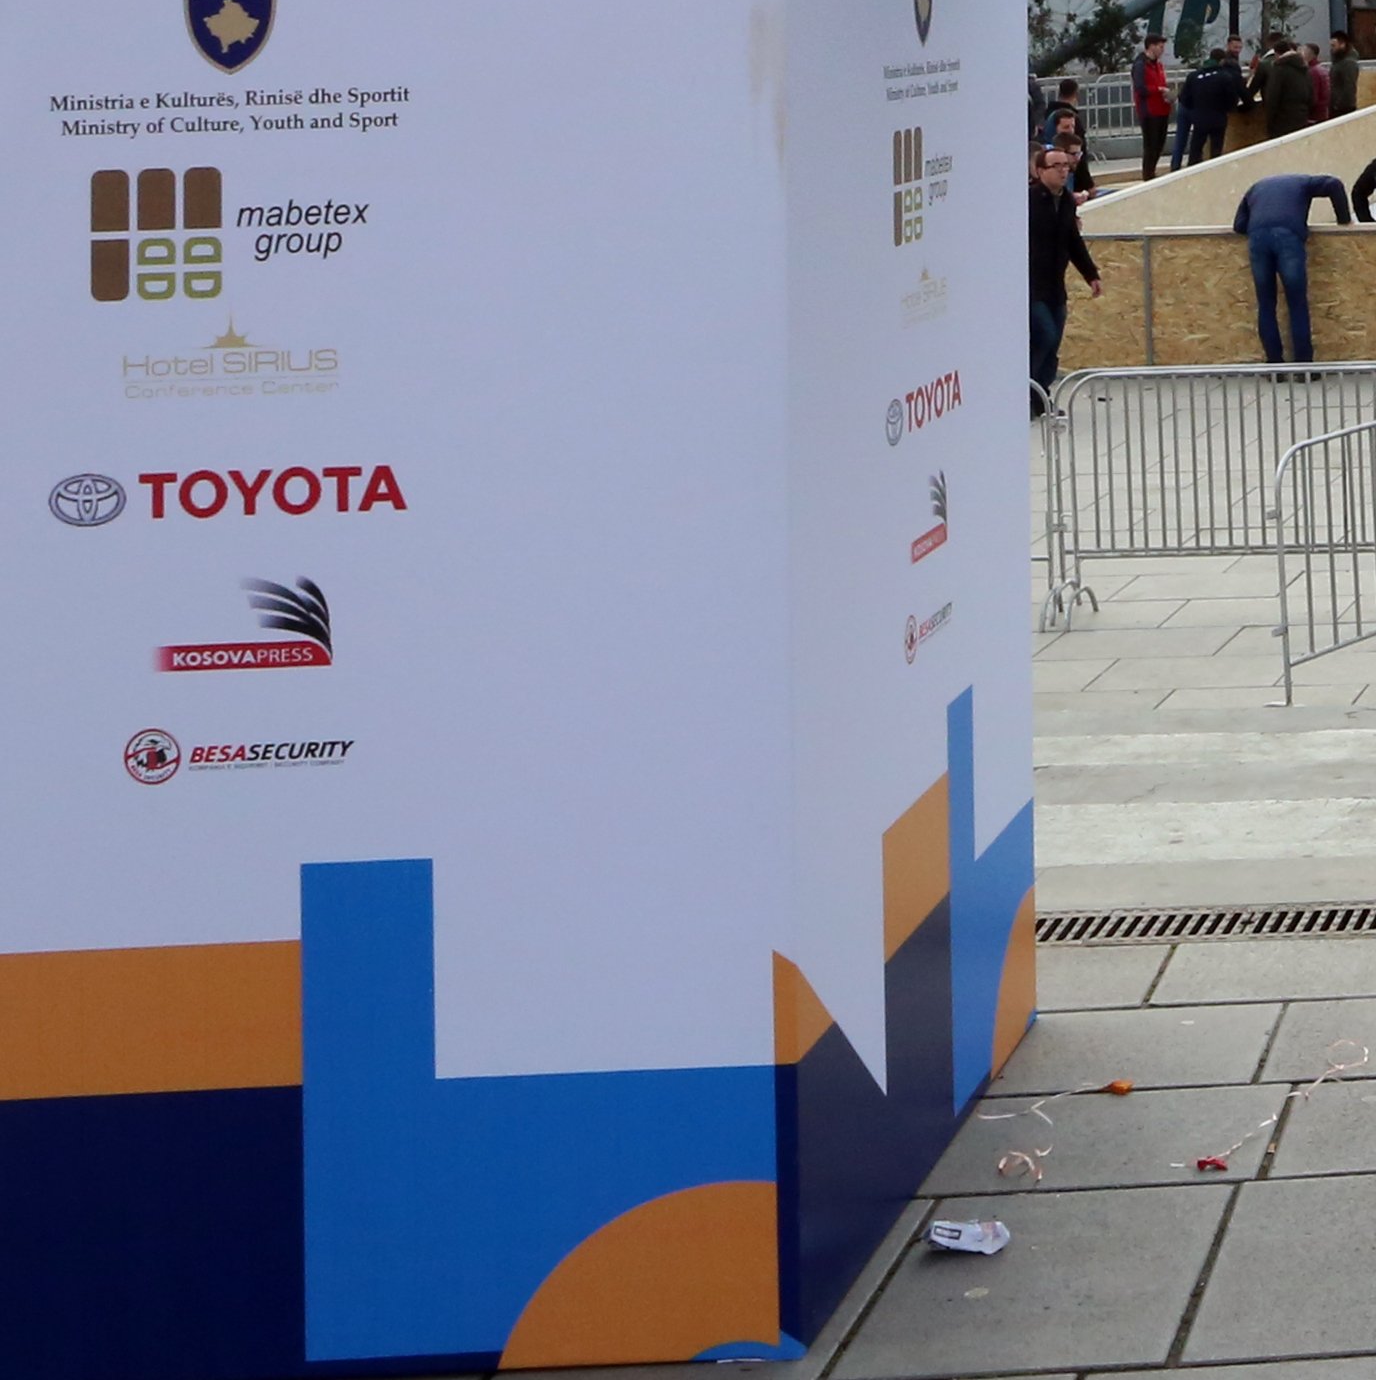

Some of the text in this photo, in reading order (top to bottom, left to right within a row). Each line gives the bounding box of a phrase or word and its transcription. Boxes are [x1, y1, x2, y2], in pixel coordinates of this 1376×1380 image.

[49, 87, 410, 112] Ministria e Kulturës, Rinisë dhe Sportit
[61, 111, 400, 139] Ministry of Culture, Youth and Sport
[237, 200, 369, 227] mabetex
[254, 230, 343, 261] group
[122, 349, 338, 378] Hotel SIRIUS
[124, 379, 340, 399] Conference Center
[906, 370, 962, 433] TOYOTA
[139, 465, 408, 519] TOYOTA
[172, 647, 313, 666] KOSOVAPRESS
